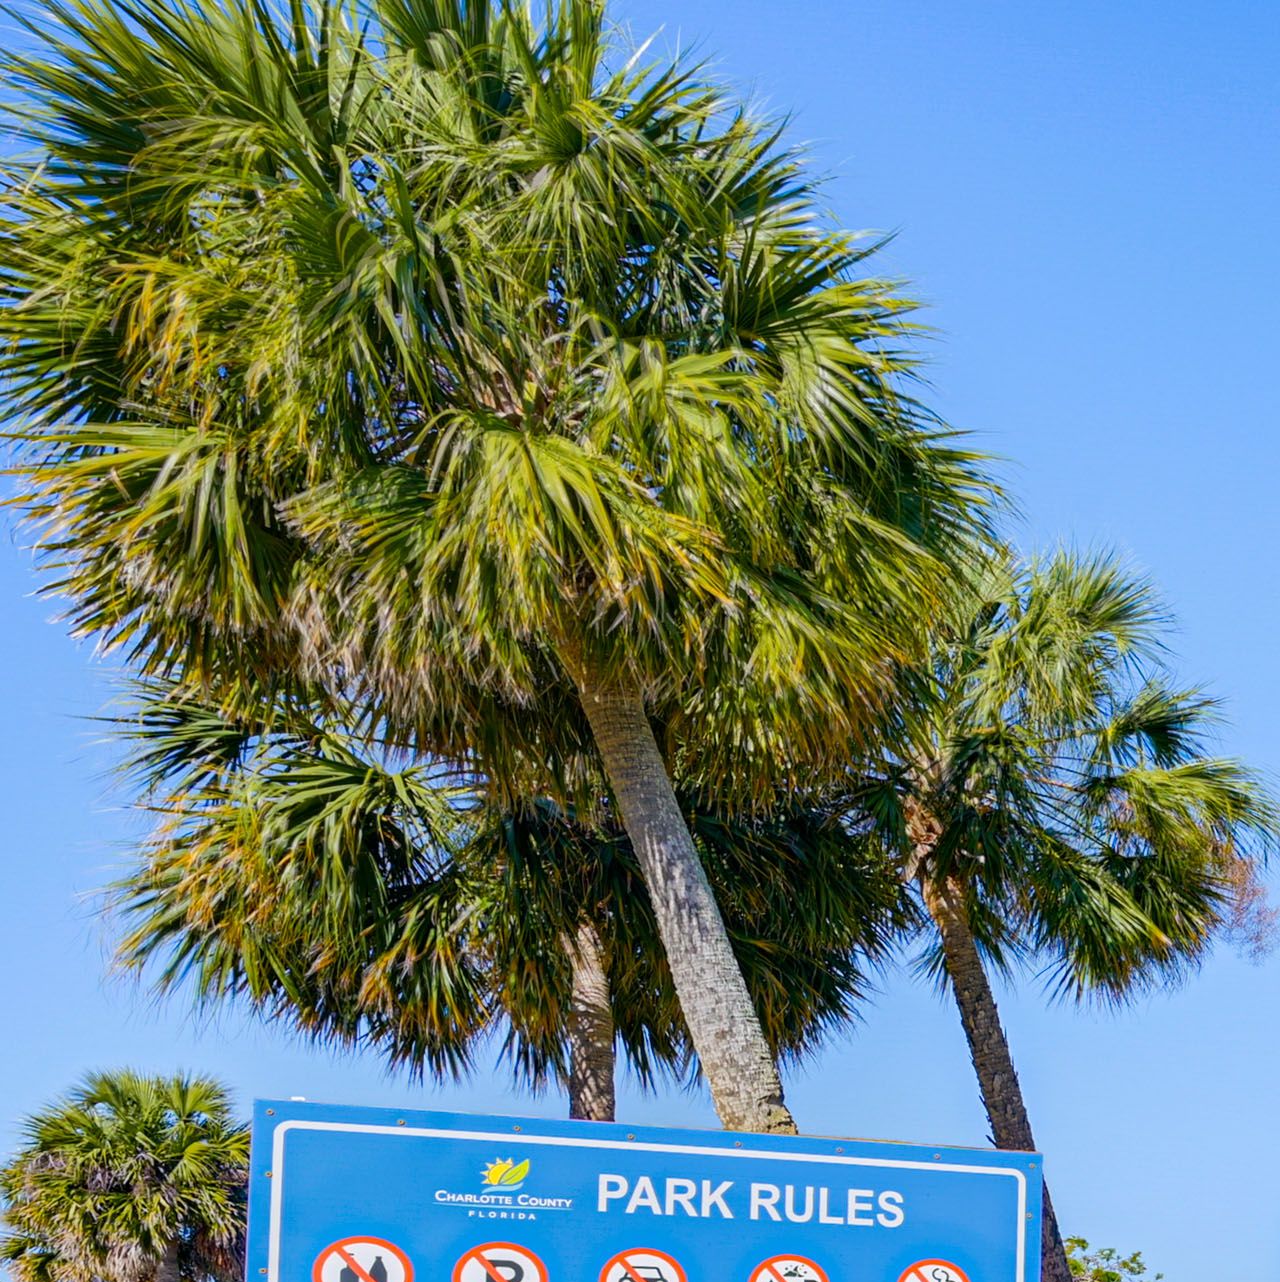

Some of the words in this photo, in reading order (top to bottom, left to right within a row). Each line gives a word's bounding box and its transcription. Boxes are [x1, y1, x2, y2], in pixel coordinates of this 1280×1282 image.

[435, 1190, 512, 1205] CHARLOTTE
[518, 1194, 572, 1208] COUNTY
[597, 1173, 734, 1219] PARK
[750, 1182, 905, 1228] RULES
[468, 1210, 536, 1220] FLORIDA
